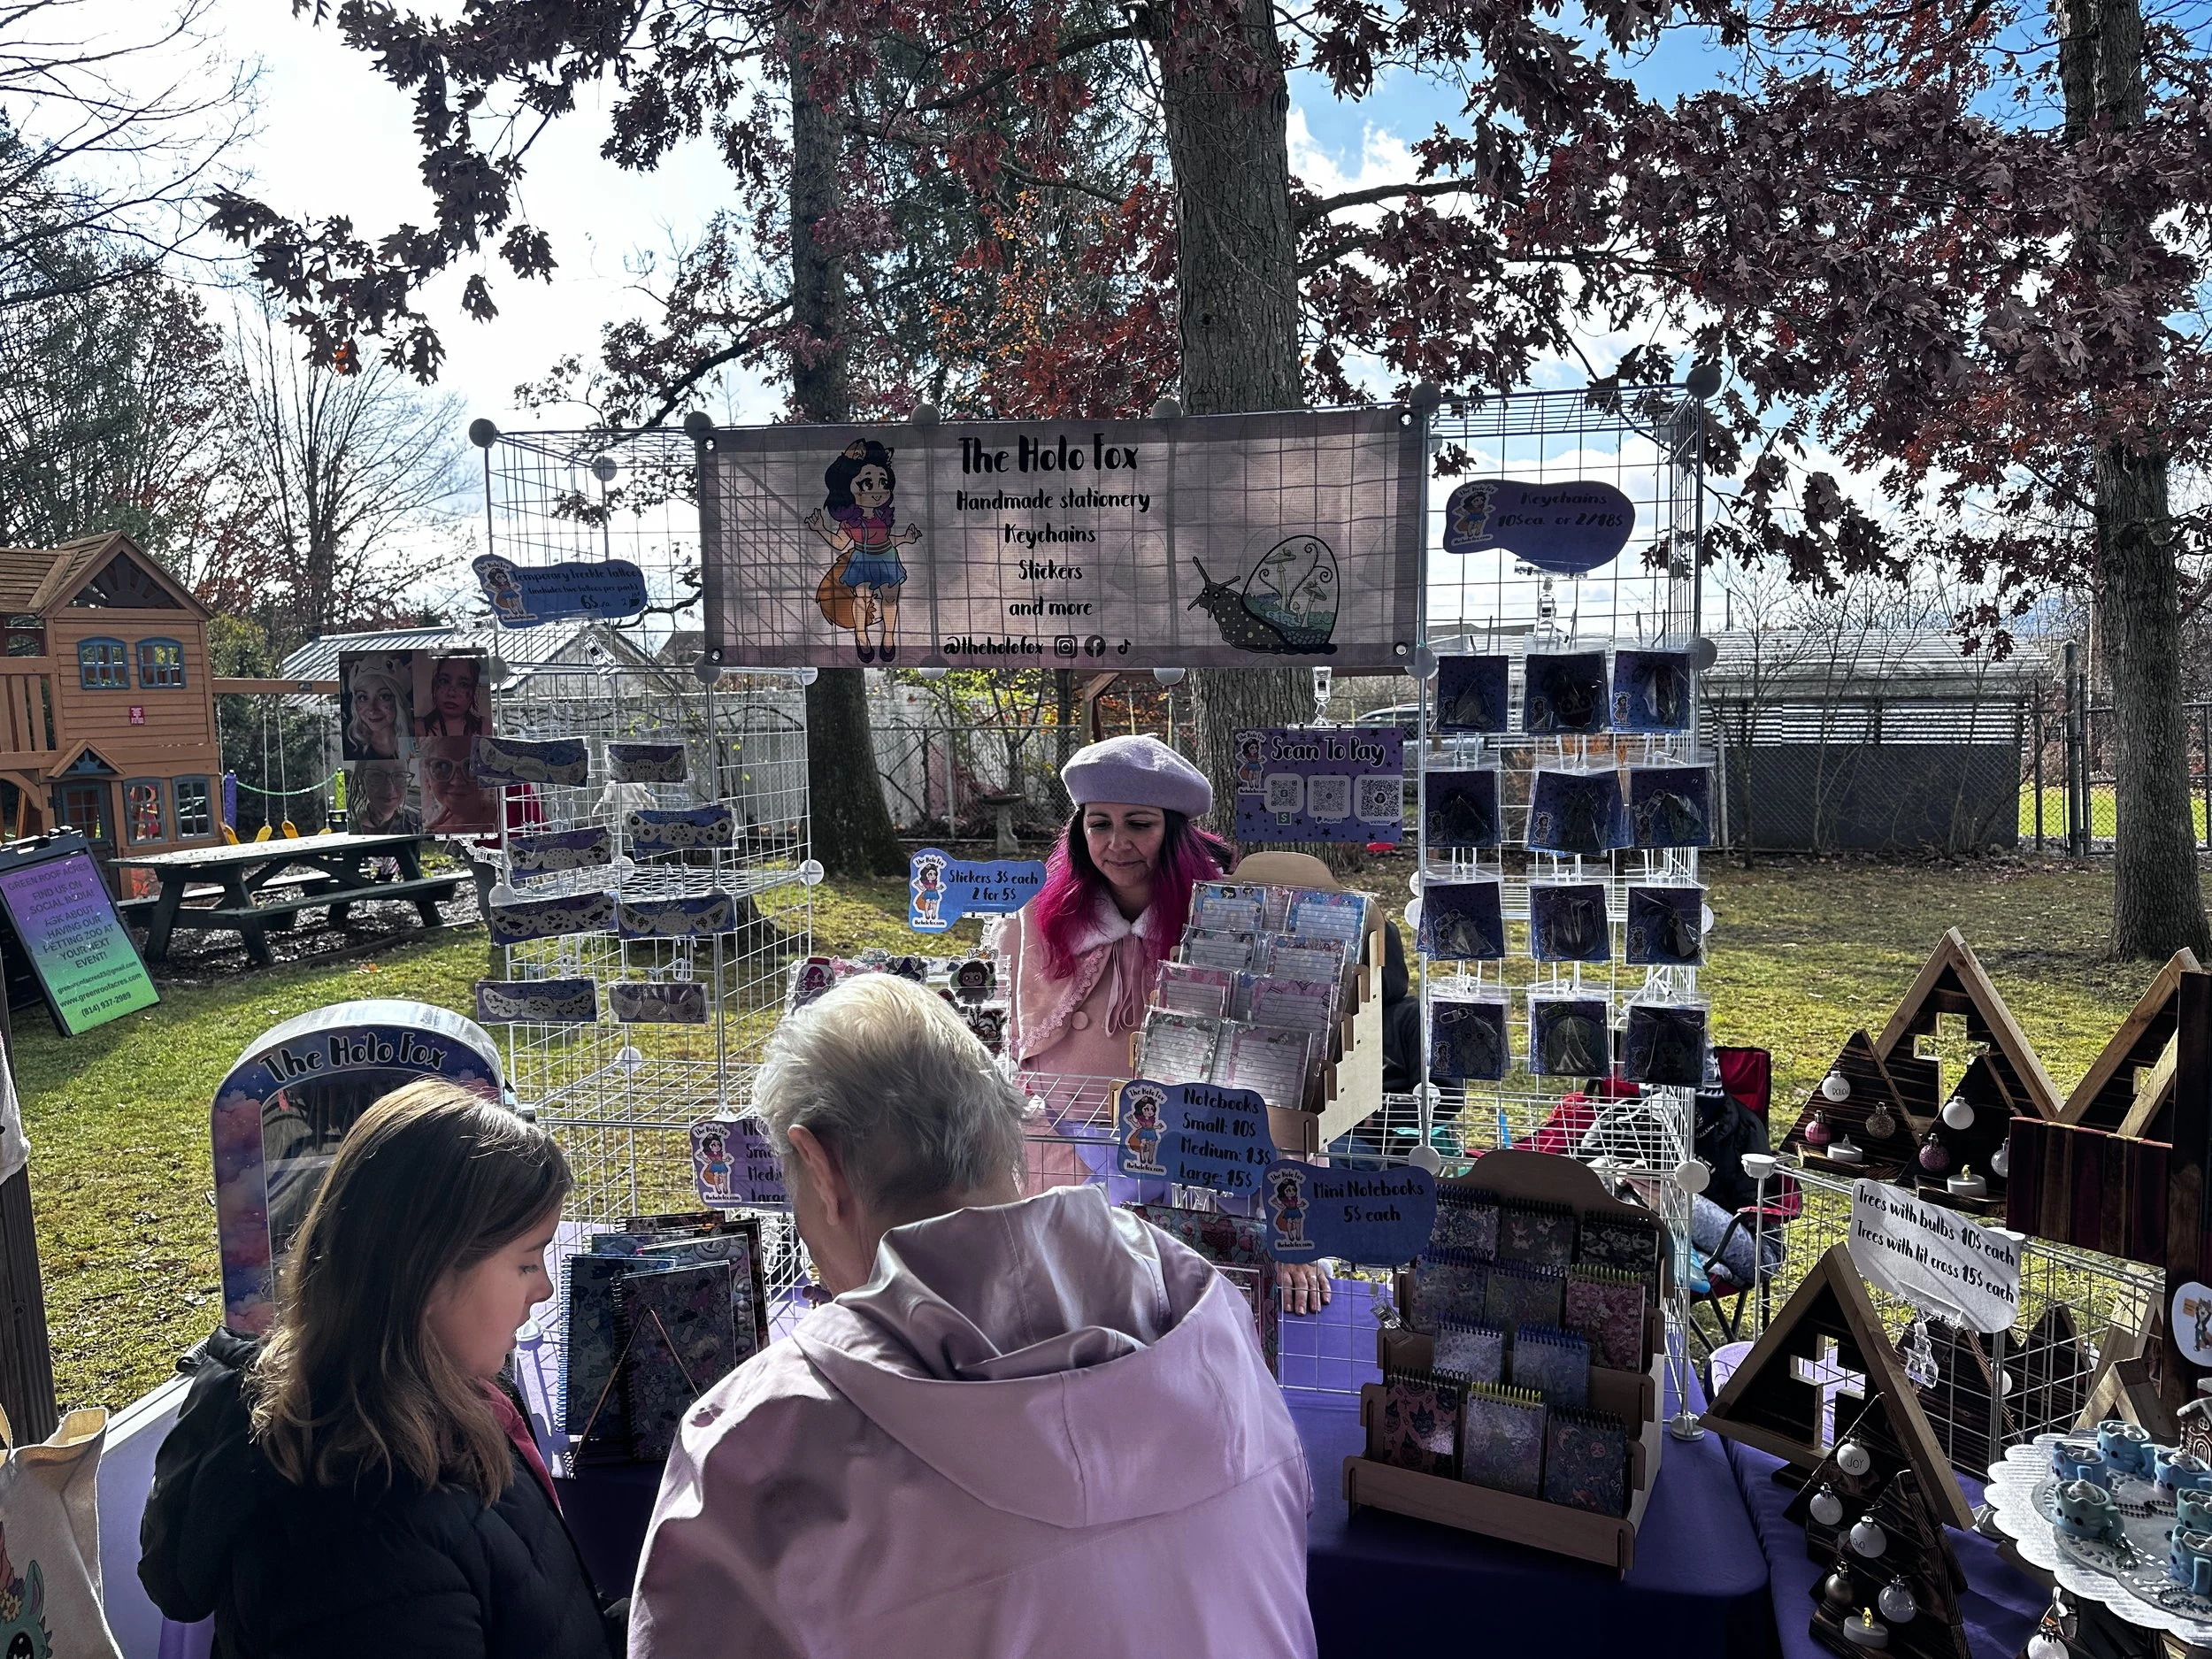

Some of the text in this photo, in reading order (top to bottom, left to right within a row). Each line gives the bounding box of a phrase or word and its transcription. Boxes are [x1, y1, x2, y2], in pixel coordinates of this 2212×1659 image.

[958, 433, 1139, 474] The Holo Fox
[956, 487, 1150, 513] Handmade stationery
[1520, 491, 1608, 507] Keychains
[1005, 522, 1096, 549] Keychains
[513, 570, 569, 582] Temporary
[1018, 559, 1083, 580] Stickers
[1009, 595, 1093, 616] and more
[943, 636, 1043, 655] @theholofox
[1271, 736, 1386, 767] Scan To Pay
[7, 863, 88, 891] GREEN ROOF ACRES
[949, 869, 1039, 885] Stickers 3$ each
[32, 879, 83, 901] FIND US ON
[972, 887, 1017, 901] 2 for 5$
[29, 898, 65, 915] SOCIAL
[44, 904, 95, 927] ASK ABOUT
[47, 915, 102, 939] HAVING OUR
[42, 924, 114, 954] PETTING ZOO AT
[59, 938, 111, 961] YOUR NEXT
[75, 951, 107, 969] EVENT!
[59, 972, 142, 1008] www.greenroofacres.com
[260, 1033, 446, 1082] The Holo Fox
[1183, 1087, 1259, 1114] Notebooks
[1182, 1112, 1256, 1139] Small: 10$
[1181, 1136, 1271, 1166] Medium: 13$
[1179, 1161, 1253, 1189] Large: 15$
[1313, 1179, 1425, 1199] Mini Notebooks
[1344, 1203, 1401, 1224] 5$ each
[1859, 1184, 2015, 1267] Trees with bulbs 10$ each
[1858, 1219, 2015, 1304] Trees with lit cross 15$ each
[1846, 1456, 1864, 1470] JOY
